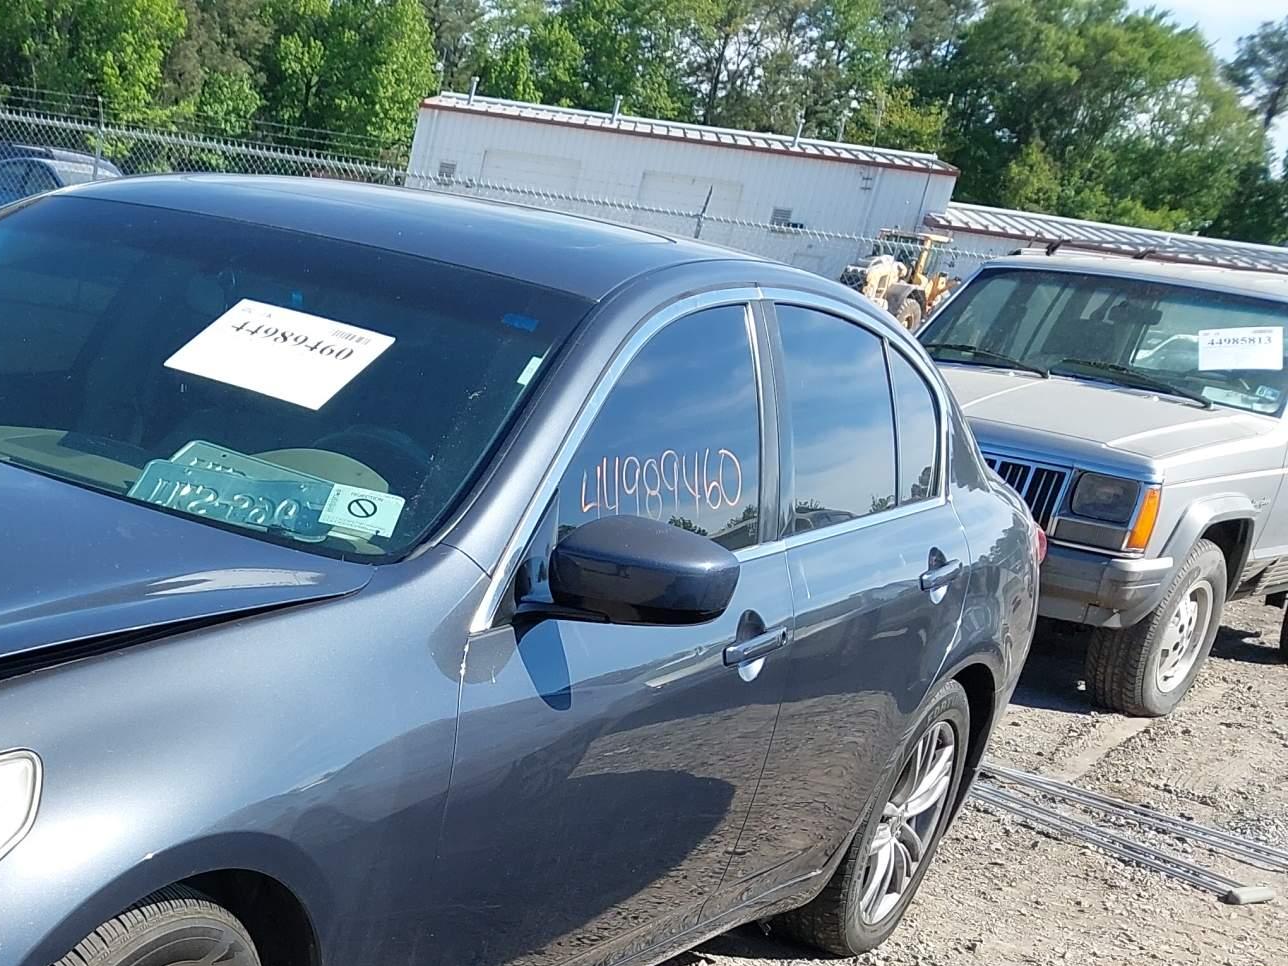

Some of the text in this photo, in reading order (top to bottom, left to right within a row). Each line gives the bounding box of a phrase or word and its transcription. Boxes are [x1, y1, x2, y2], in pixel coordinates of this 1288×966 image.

[231, 320, 354, 361] 44989460
[1207, 336, 1272, 346] 44985813
[581, 448, 742, 520] 44989460
